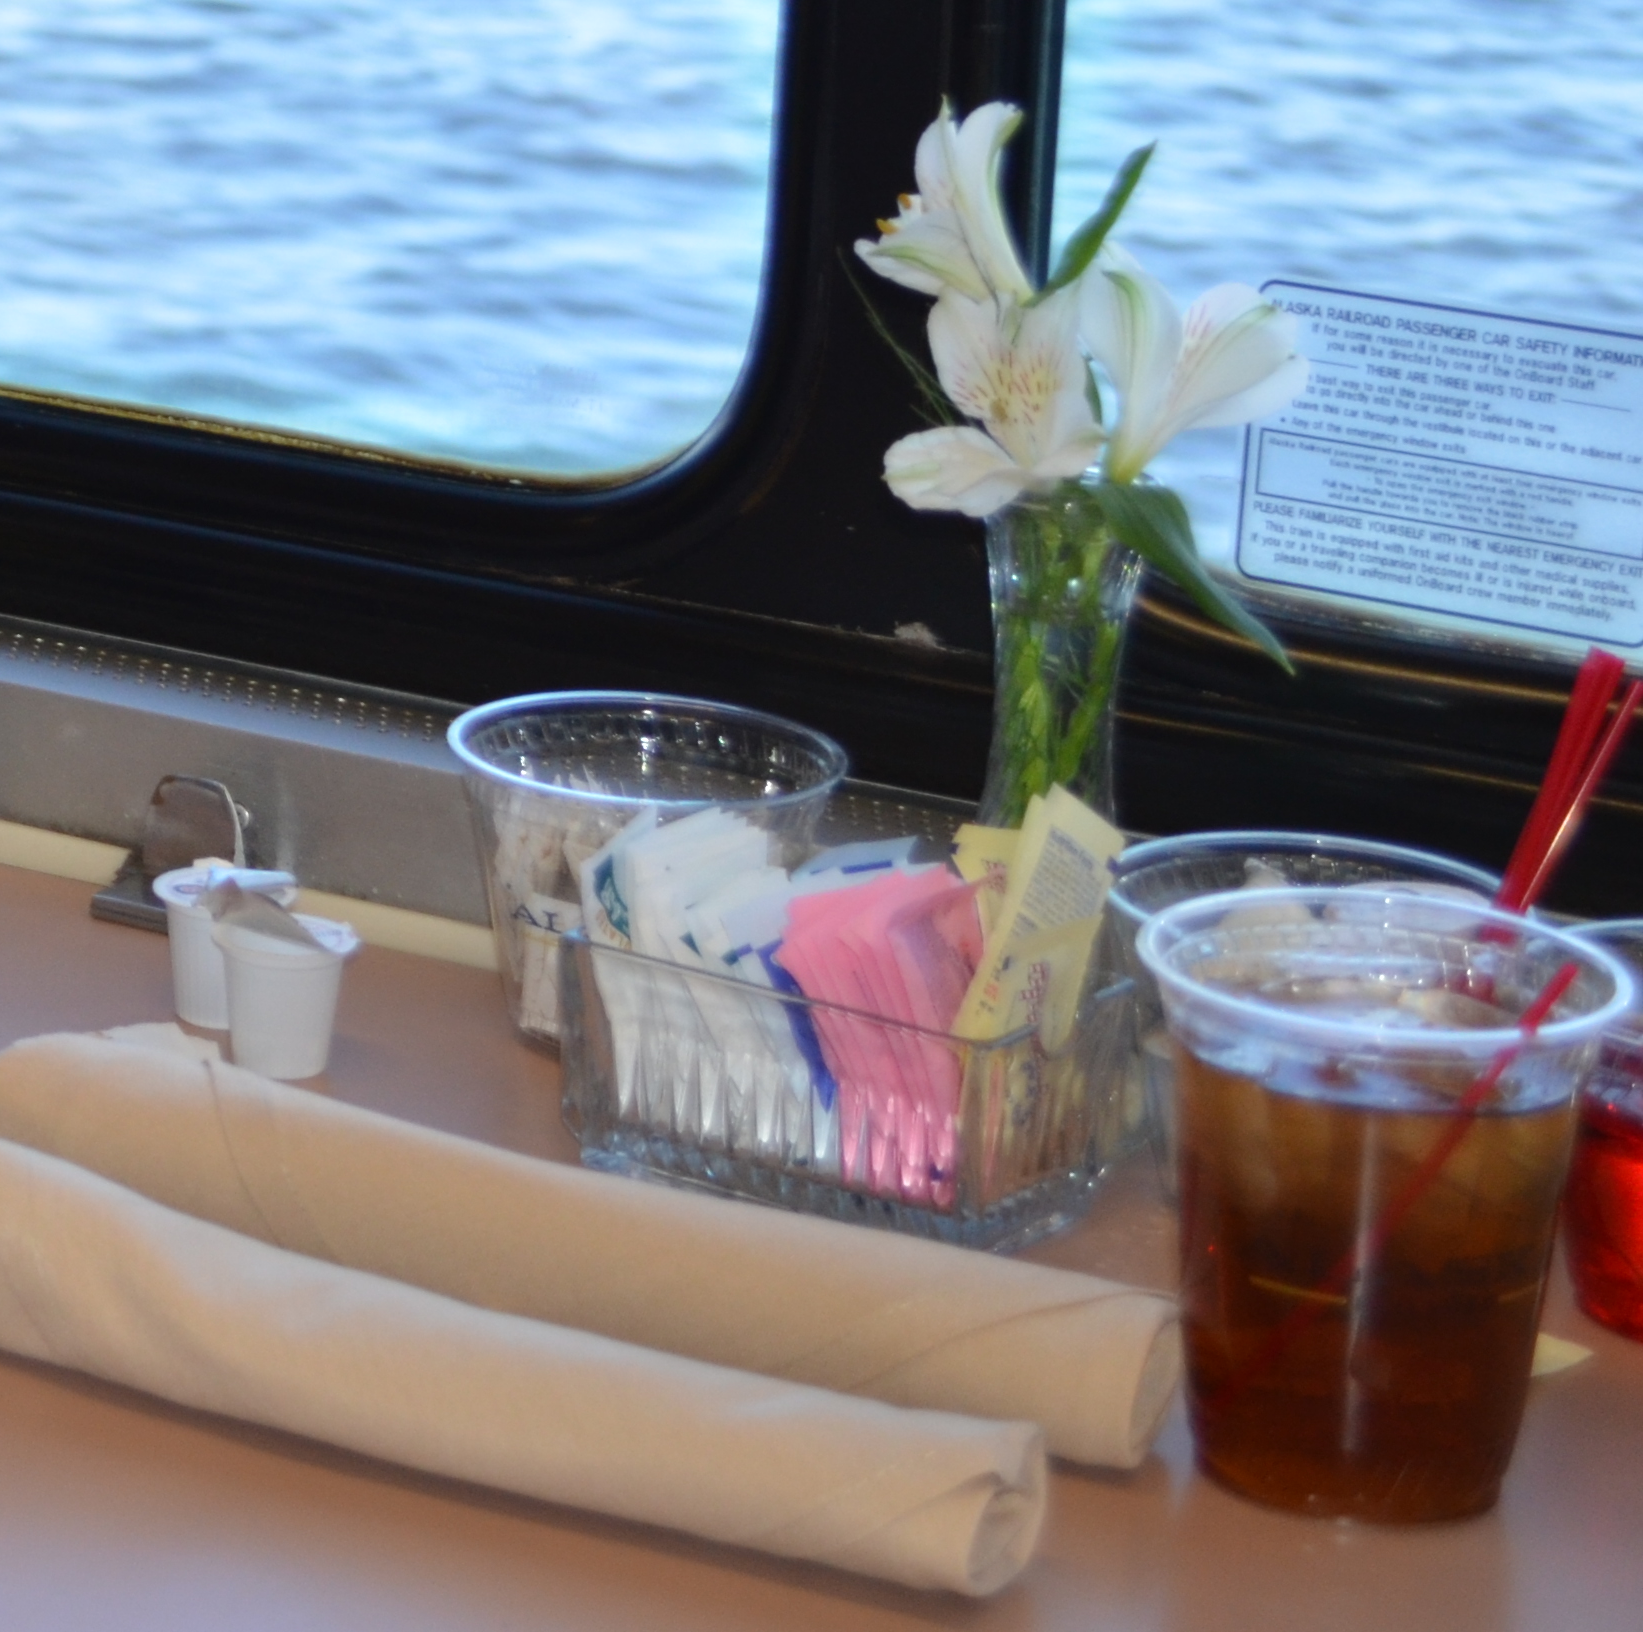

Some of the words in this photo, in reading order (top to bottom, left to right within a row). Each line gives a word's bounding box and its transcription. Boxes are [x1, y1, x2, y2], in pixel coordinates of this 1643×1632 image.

[1312, 323, 1319, 333] If
[1324, 325, 1337, 335] for
[1344, 330, 1371, 341] some
[1377, 335, 1412, 347] reason
[1417, 340, 1425, 349] it
[1428, 341, 1437, 351] is
[1443, 346, 1497, 363] necessary
[1503, 353, 1513, 363] to
[1519, 357, 1567, 371] evacuate
[1574, 364, 1590, 375] this
[1327, 308, 1390, 328] RAILROAD
[1397, 318, 1475, 341] PASSENGER
[1482, 331, 1508, 346] CAR
[1517, 337, 1567, 355] SAFETY
[1327, 342, 1344, 351] you
[1350, 345, 1366, 354] will
[1371, 346, 1382, 356] be
[1389, 349, 1431, 364] directed
[1435, 357, 1446, 369] by
[1454, 361, 1471, 371] one
[1478, 364, 1488, 374] of
[1493, 366, 1509, 376] the
[1516, 369, 1562, 385] OnBoard
[1569, 378, 1594, 390] Staff
[1366, 365, 1399, 378] THERE
[1406, 371, 1426, 383] ARE
[1434, 375, 1466, 389] THREE
[1475, 382, 1503, 395] WAYS
[1510, 387, 1522, 398] TO
[1317, 375, 1336, 385] best
[1342, 381, 1359, 391] way
[1364, 382, 1373, 392] to
[1377, 385, 1394, 395] exit
[1400, 388, 1415, 397] this
[1420, 393, 1469, 407] passenger
[1476, 401, 1489, 410] car
[1320, 388, 1330, 398] go
[1335, 390, 1368, 404] directly
[1374, 396, 1389, 405] into
[1395, 399, 1409, 408] the
[1415, 403, 1428, 412] car
[1434, 407, 1462, 417] ahead
[1466, 412, 1475, 420] or
[1481, 413, 1512, 425] behind
[1516, 419, 1532, 428] this
[1538, 423, 1555, 433] one
[1292, 417, 1307, 429] Any
[1313, 421, 1322, 430] of
[1327, 423, 1341, 432] the
[1346, 428, 1396, 444] emergency
[1403, 437, 1437, 448] window
[1293, 399, 1318, 410] Leave
[1323, 404, 1338, 413] this
[1344, 408, 1357, 418] car
[1363, 411, 1398, 425] through
[1403, 417, 1417, 426] the
[1423, 422, 1463, 434] vestibule
[1468, 428, 1504, 441] located
[1508, 435, 1519, 444] on
[1525, 437, 1540, 447] this
[1546, 441, 1555, 450] or
[1561, 443, 1574, 452] the
[1581, 447, 1621, 460] adjacent
[1628, 454, 1640, 464] car
[1253, 501, 1291, 515] PLEASE
[1299, 509, 1360, 527] FAMILIARIZE
[1369, 521, 1424, 538] YOURSELF
[1431, 532, 1455, 544] WITH
[1462, 537, 1480, 548] THE
[1488, 542, 1537, 558] NEAREST
[1544, 551, 1613, 572] EMERGENCY
[1266, 521, 1284, 532] This
[1290, 525, 1312, 537] train
[1316, 530, 1325, 539] is
[1330, 534, 1378, 548] equipped
[1383, 543, 1403, 553] with
[1409, 546, 1429, 557] first
[1436, 552, 1449, 561] aid
[1455, 554, 1472, 565] kits
[1479, 560, 1498, 569] and
[1503, 564, 1529, 575] other
[1536, 570, 1576, 583] medical
[1251, 533, 1258, 542] If
[1263, 537, 1280, 546] you
[1285, 540, 1295, 549] or
[1299, 542, 1307, 551] a
[1311, 544, 1354, 561] traveling
[1359, 554, 1415, 570] companion
[1421, 563, 1468, 579] becomes
[1474, 572, 1483, 582] ill
[1488, 576, 1497, 585] or
[1503, 577, 1511, 587] is
[1517, 580, 1552, 594] injured
[1558, 589, 1582, 599] while
[1275, 553, 1307, 565] please
[1313, 560, 1341, 574] notify
[1346, 565, 1354, 574] a
[1358, 568, 1411, 584] uniformed
[1416, 577, 1462, 593] OnBoard
[1467, 588, 1491, 598] crew
[1498, 593, 1539, 607] member
